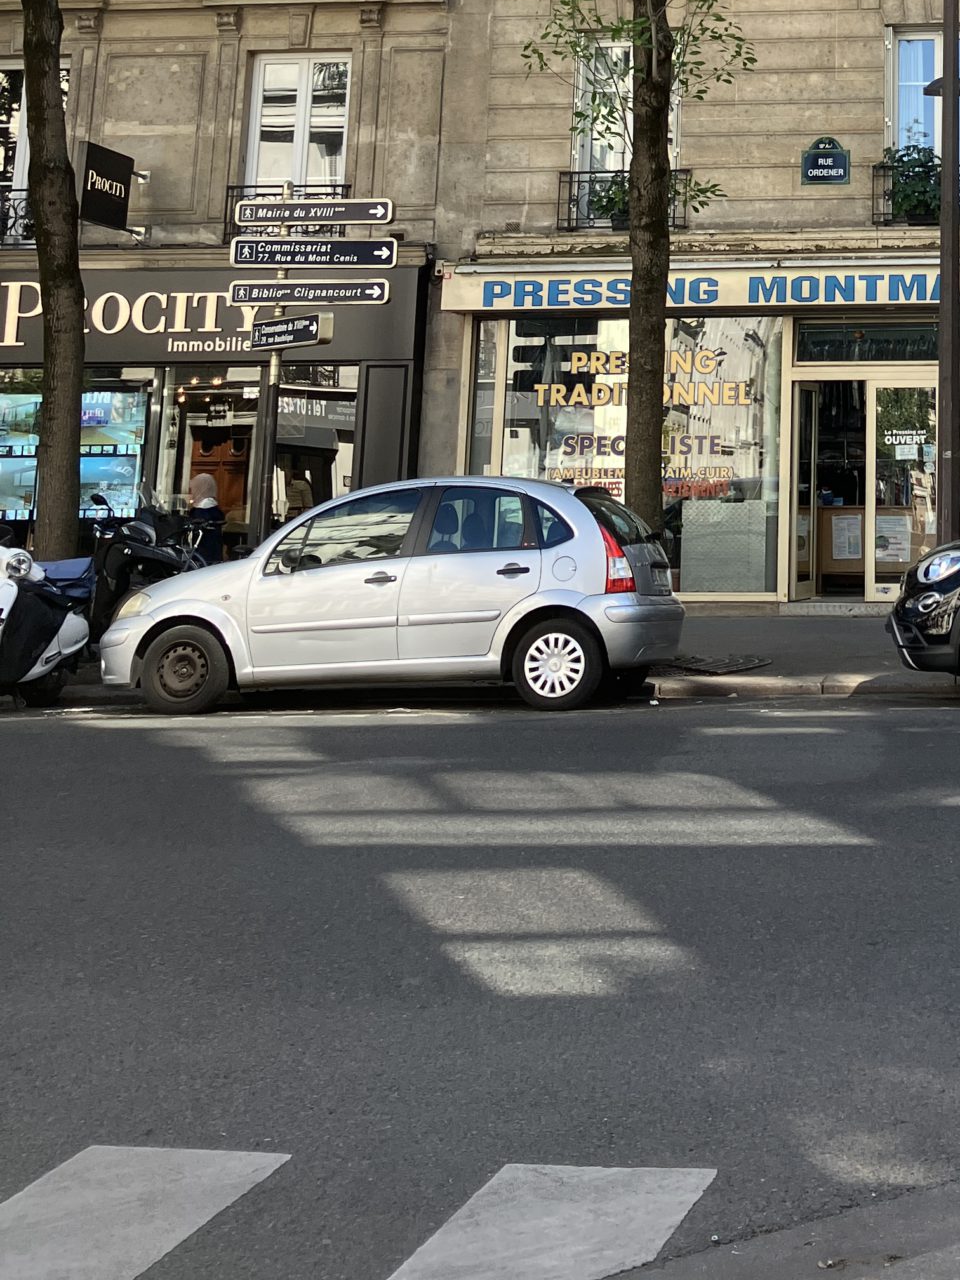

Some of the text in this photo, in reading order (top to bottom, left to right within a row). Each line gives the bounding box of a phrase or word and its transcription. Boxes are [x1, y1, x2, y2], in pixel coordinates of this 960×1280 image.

[818, 158, 833, 166] RUE
[807, 168, 844, 177] ORDENER
[87, 169, 125, 198] PROCITY
[257, 208, 290, 218] Mairie
[293, 208, 305, 217] du
[257, 243, 331, 252] Commissariat
[275, 252, 291, 262] Rue
[294, 252, 305, 261] du
[308, 252, 330, 262] Mont
[333, 252, 358, 262] Cenis
[294, 287, 361, 299] Clignancourt
[482, 277, 719, 308] PRESSNG
[0, 281, 261, 347] POCITY
[167, 337, 251, 352] Immobilie
[571, 351, 718, 374] PREING
[534, 382, 752, 406] TRADINNEL
[563, 435, 721, 456] SPECISTE
[884, 435, 927, 445] OUVERT
